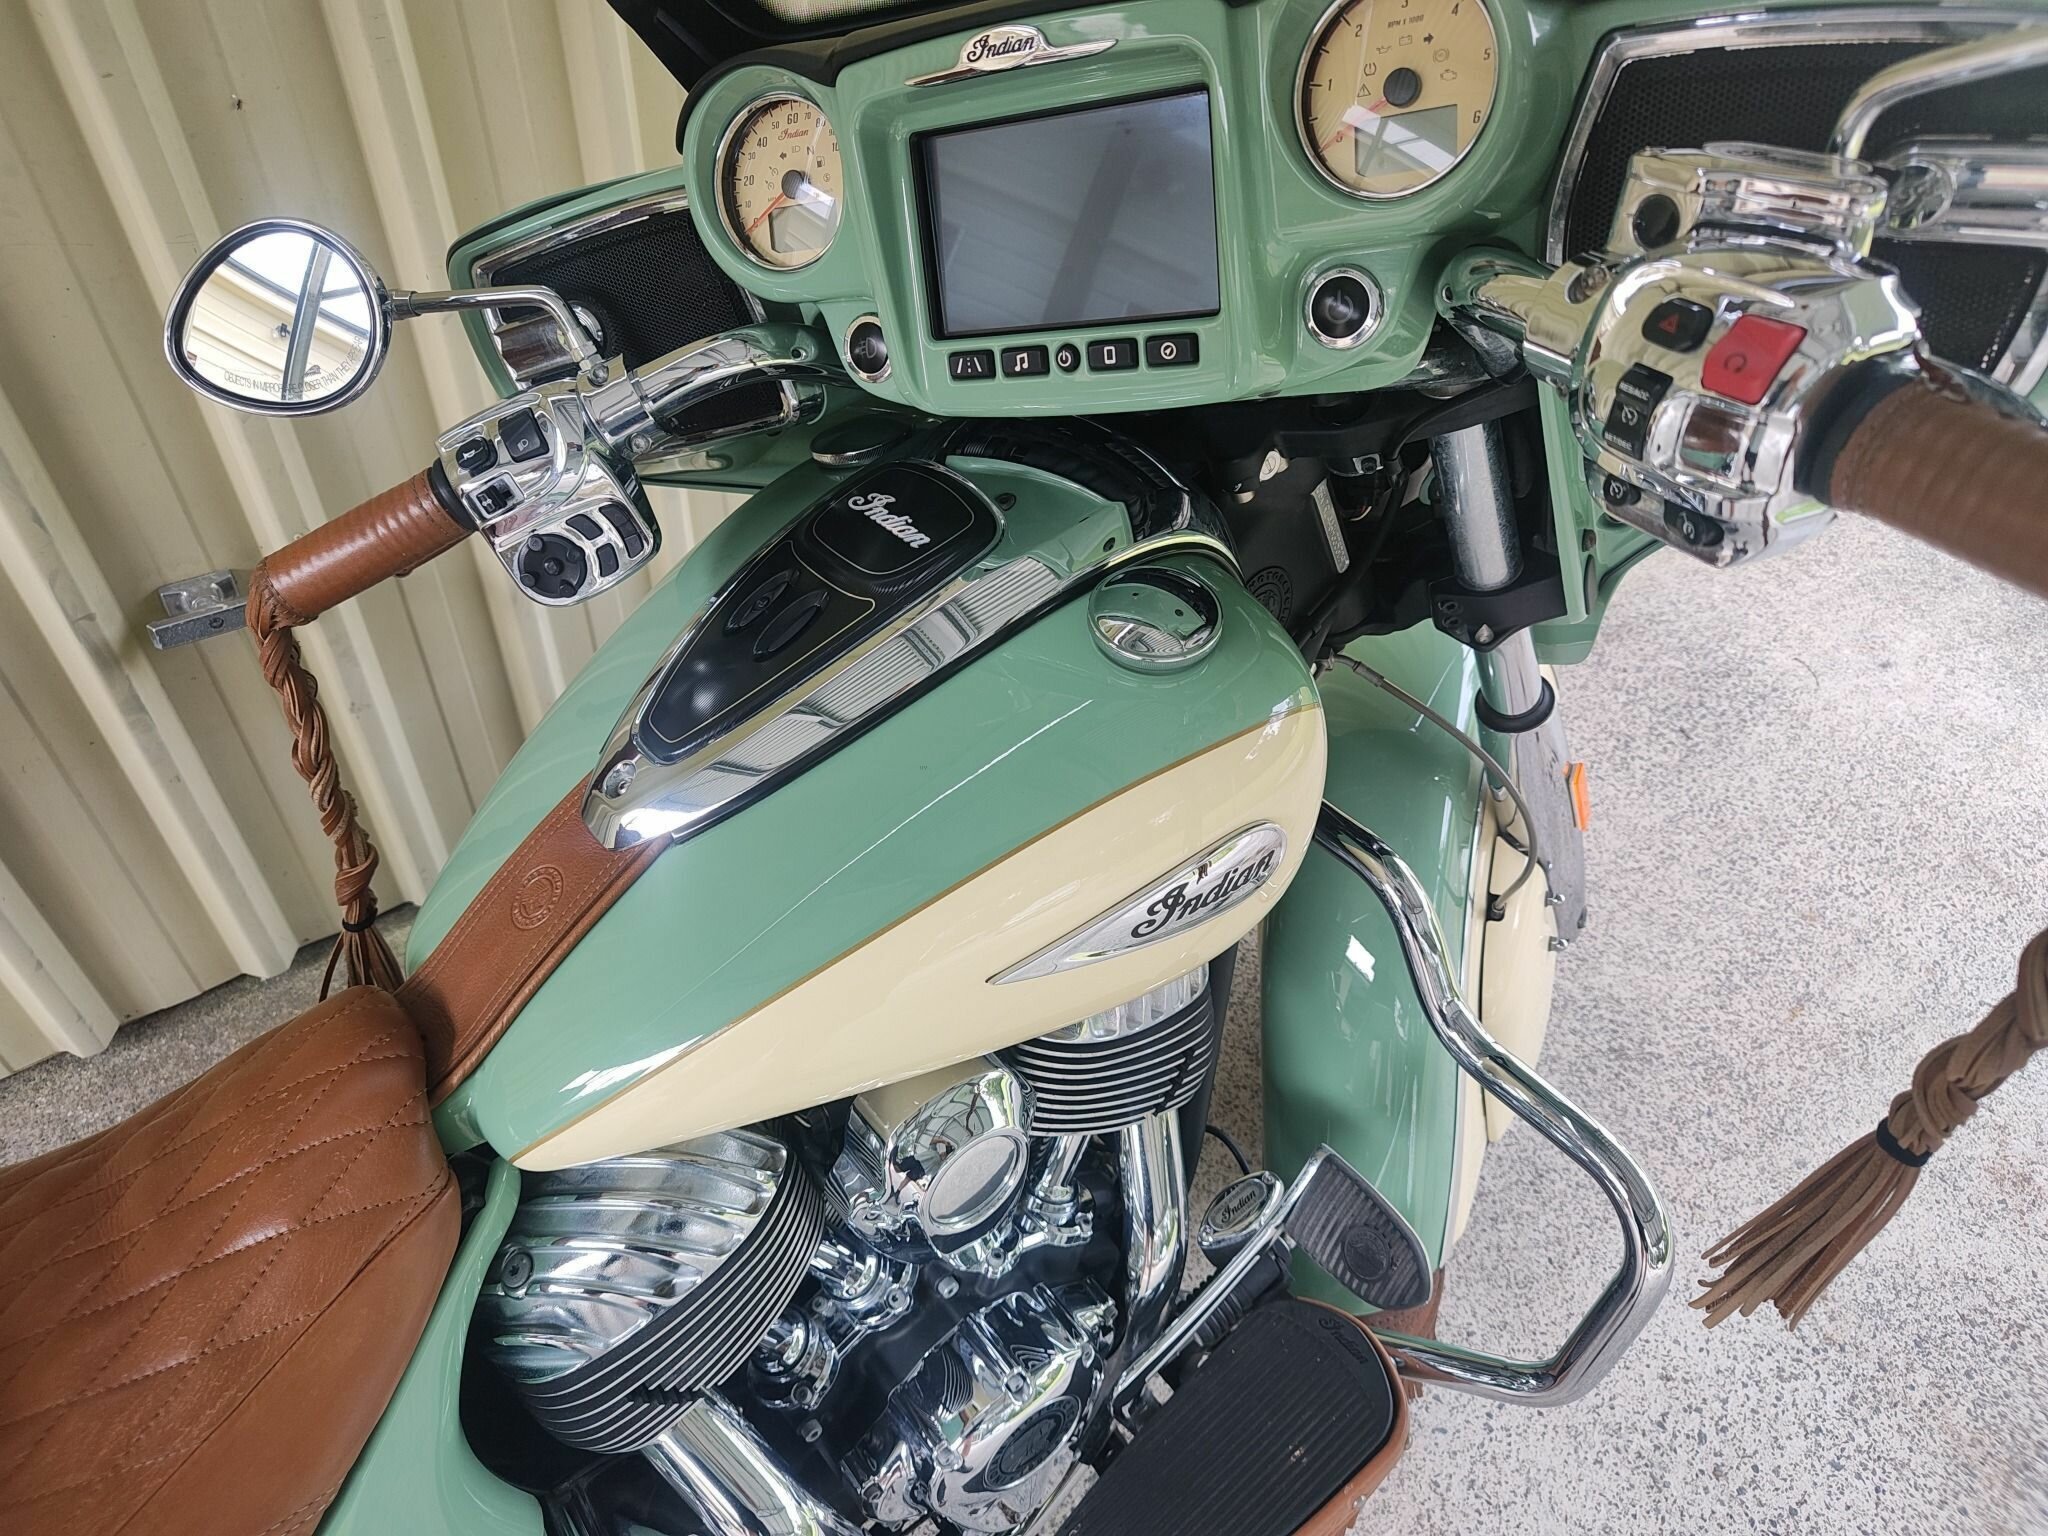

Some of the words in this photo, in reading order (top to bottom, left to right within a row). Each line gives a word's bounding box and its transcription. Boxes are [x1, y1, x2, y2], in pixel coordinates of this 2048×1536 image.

[1451, 2, 1460, 17] 4
[1354, 23, 1363, 38] 2
[966, 34, 1036, 63] Indian
[1483, 47, 1491, 62] 5
[1327, 78, 1334, 92] 1
[786, 112, 799, 125] 60
[803, 111, 812, 120] 70
[1473, 109, 1482, 125] 6
[771, 120, 780, 130] 50
[777, 127, 810, 141] Indian
[756, 136, 768, 148] 40
[747, 151, 756, 161] 30
[806, 146, 816, 156] N
[743, 174, 755, 187] 20
[744, 200, 752, 209] 10
[223, 369, 253, 390] OBJECTS
[847, 492, 932, 550] Indian
[1130, 849, 1277, 939] Indian
[1220, 1189, 1257, 1224] Indian
